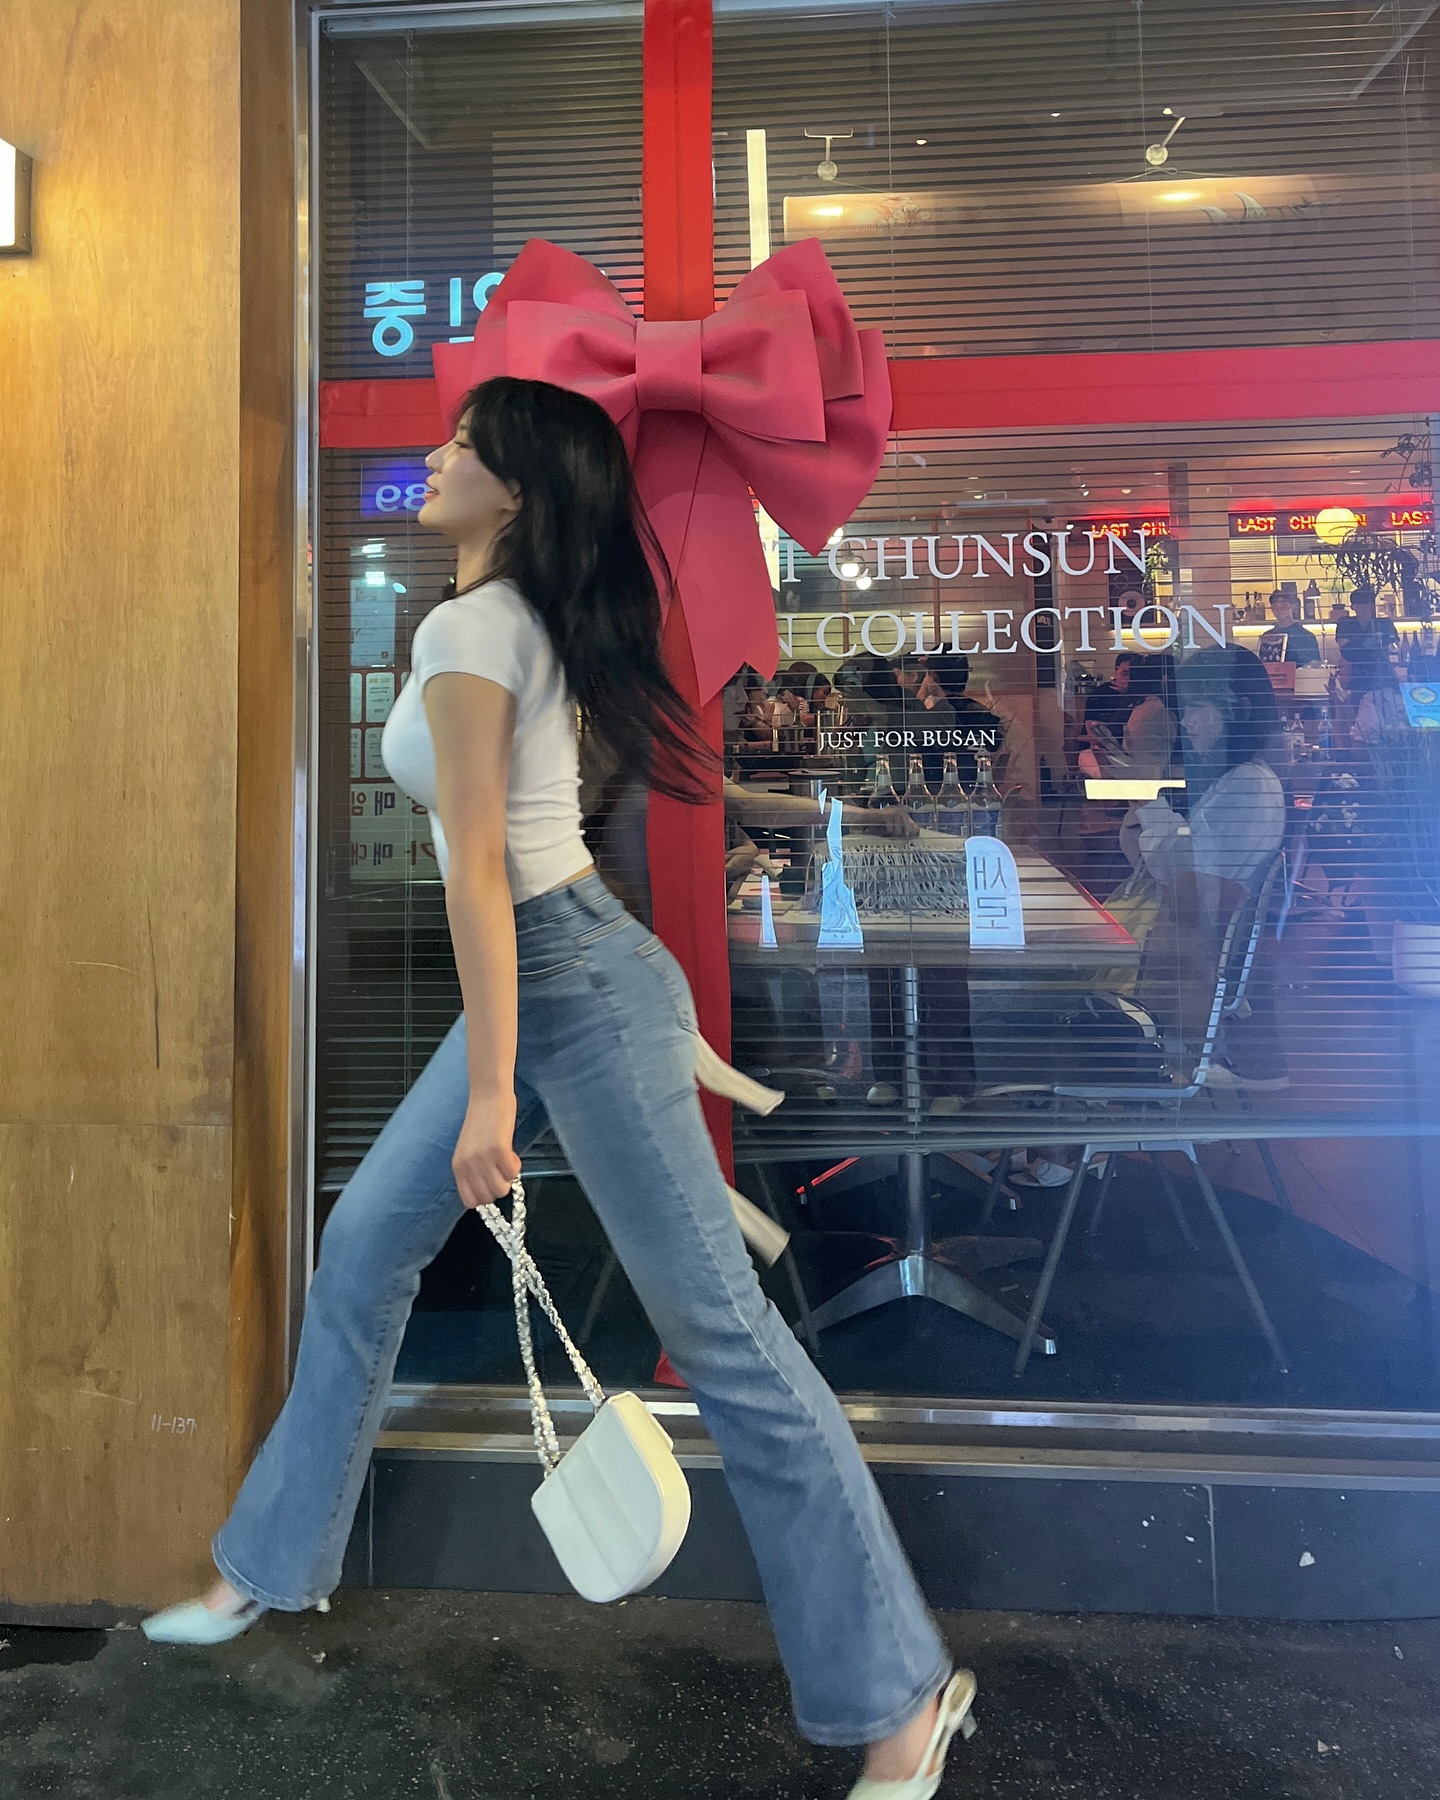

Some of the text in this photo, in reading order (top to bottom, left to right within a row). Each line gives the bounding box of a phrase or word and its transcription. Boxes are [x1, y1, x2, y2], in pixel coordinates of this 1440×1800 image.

[1237, 517, 1278, 532] LAST
[827, 528, 1149, 582] CHUNSUN
[815, 603, 1231, 659] COLLECTION
[819, 729, 997, 752] JUST FOR BUSAN
[151, 1413, 196, 1437] 11-137
